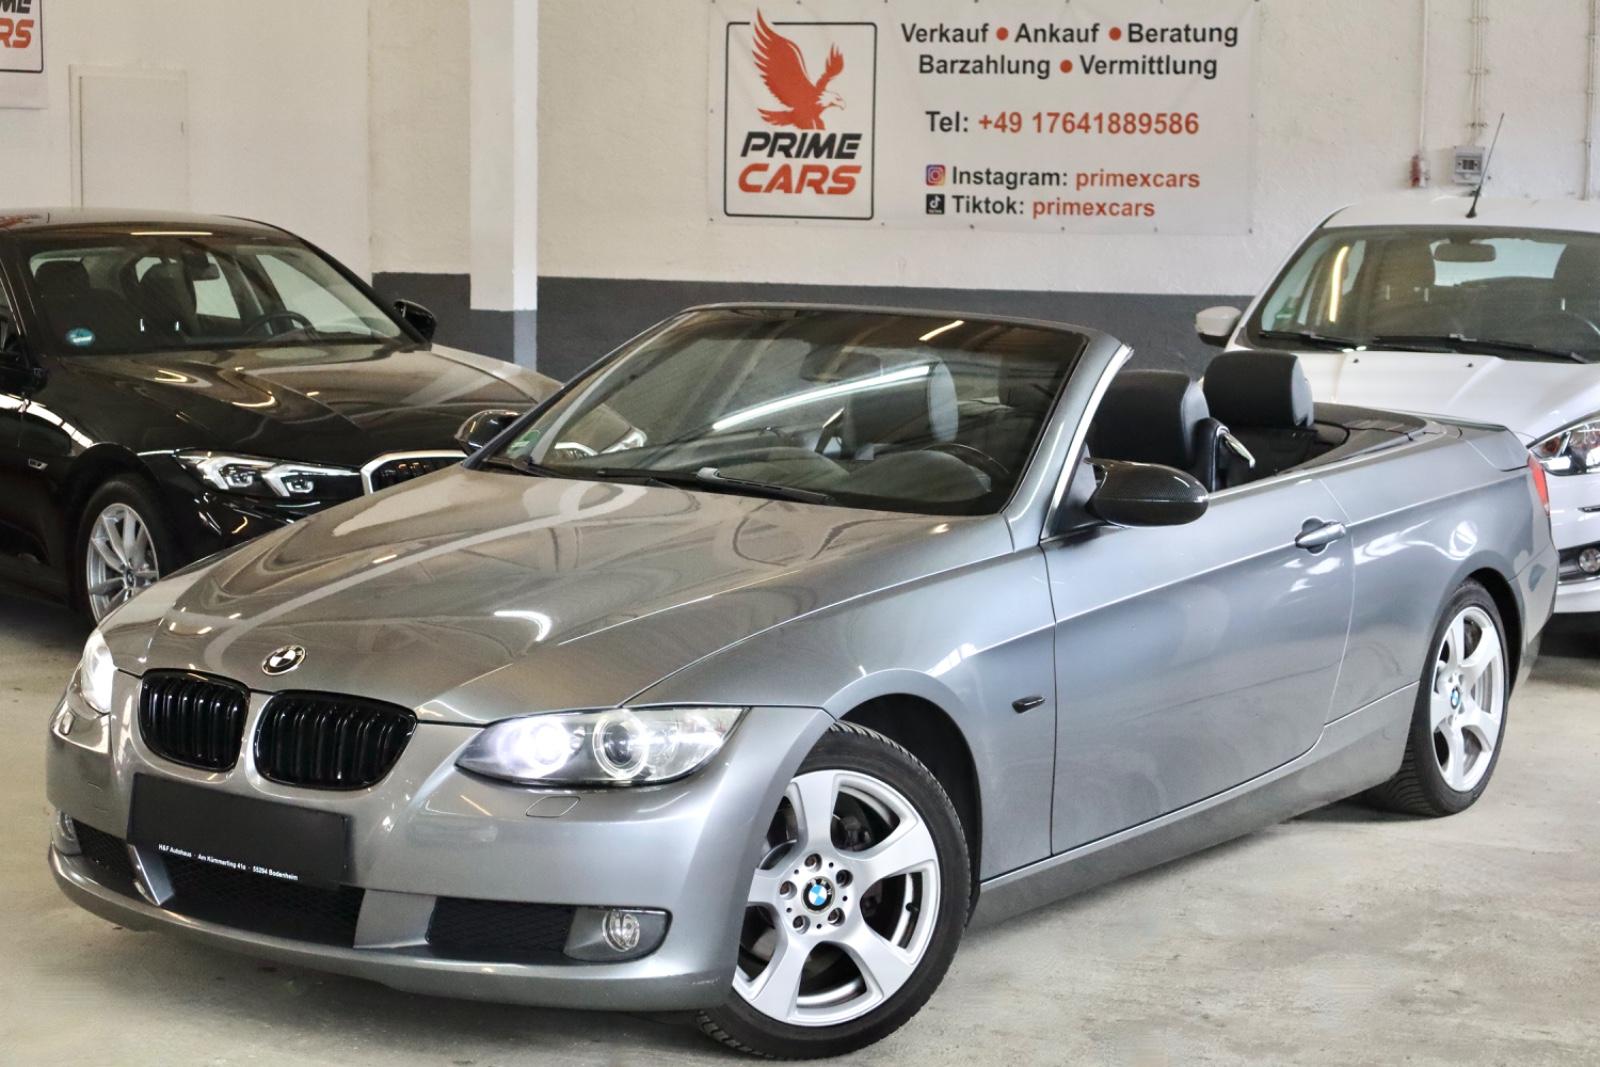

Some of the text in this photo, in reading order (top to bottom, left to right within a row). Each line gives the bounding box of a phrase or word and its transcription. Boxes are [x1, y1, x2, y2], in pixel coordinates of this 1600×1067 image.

[901, 22, 1238, 47] Verkauf Ankauf Beratung
[919, 54, 1217, 80] Barzahlung Vermittlung
[925, 110, 1200, 135] Tel: +49 17641889586
[740, 131, 862, 159] PRIME
[738, 163, 862, 195] CARS
[952, 166, 1200, 191] Instagram: primexcars
[952, 195, 1155, 219] Tiktok: primexcars
